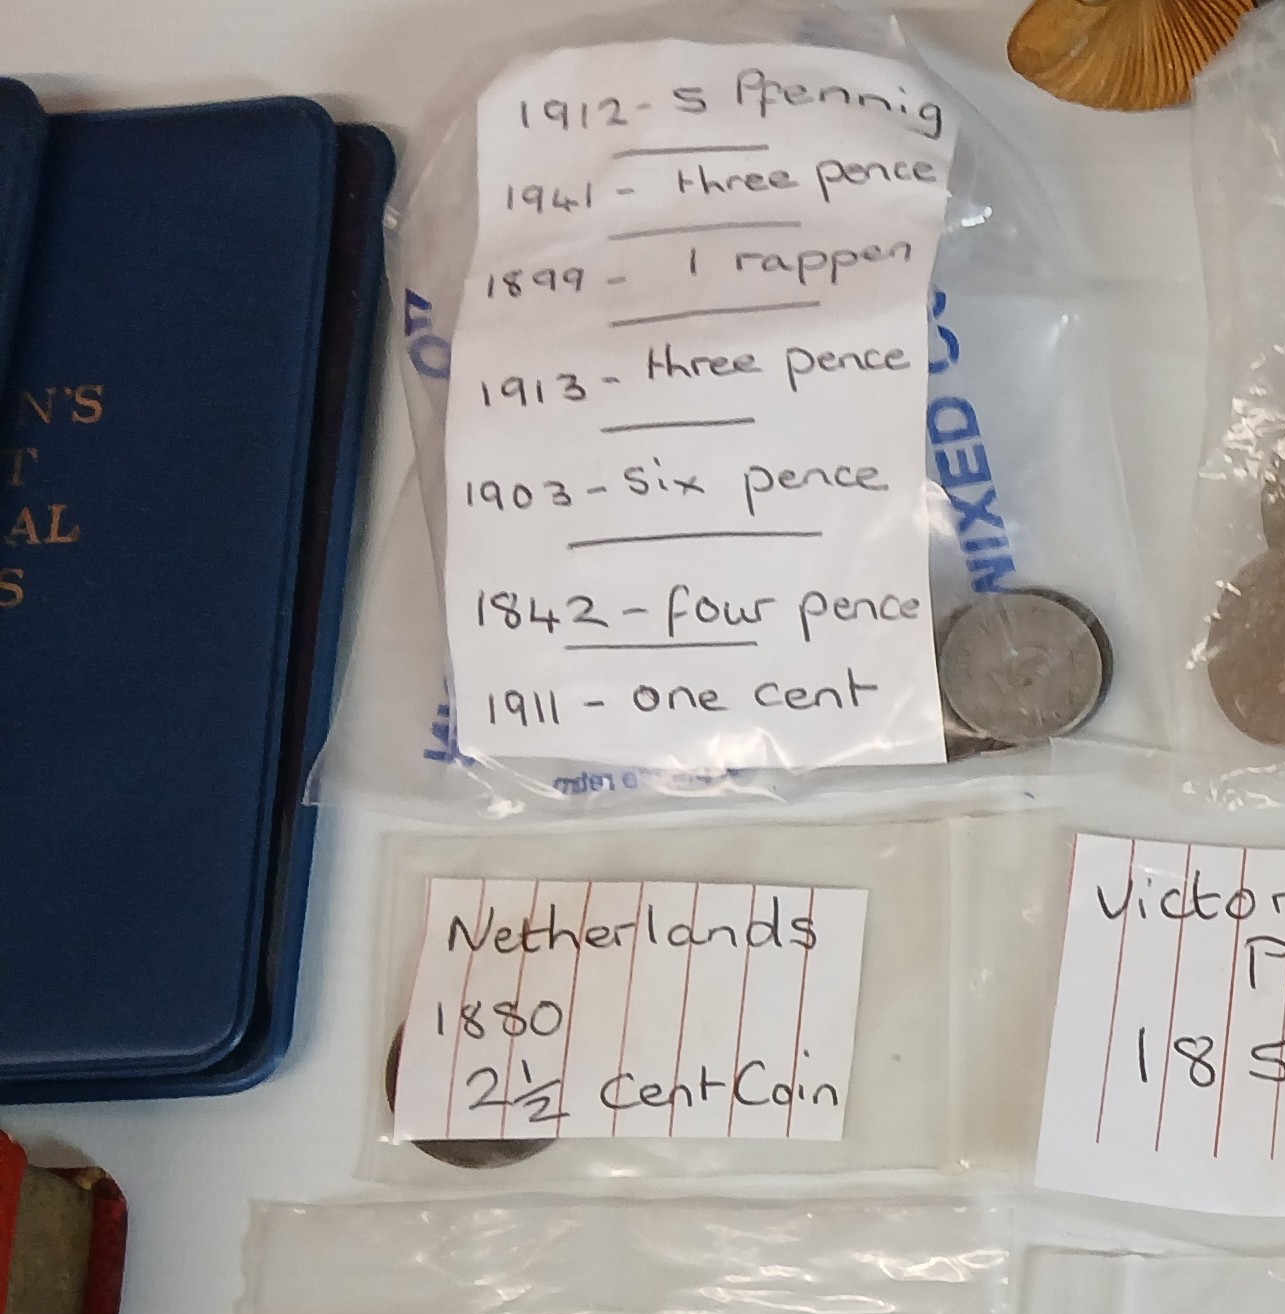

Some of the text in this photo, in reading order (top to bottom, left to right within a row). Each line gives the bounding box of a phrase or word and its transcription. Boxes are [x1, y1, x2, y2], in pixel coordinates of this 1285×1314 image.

[507, 181, 592, 214] 1941
[678, 166, 799, 195] three
[815, 158, 936, 203] pence
[486, 268, 584, 298] 1899
[736, 240, 911, 285] rappen
[481, 373, 587, 407] 1913
[649, 343, 761, 380] three
[786, 347, 910, 391] pence
[467, 481, 572, 510] 1903
[744, 464, 889, 515] pence
[476, 589, 608, 633] 1842
[668, 584, 776, 638] four
[799, 590, 920, 642] pence
[488, 691, 559, 726] 1911
[633, 684, 728, 712] one
[755, 669, 878, 709] cent
[447, 896, 817, 953] Netherlands
[437, 1000, 563, 1039] 1880
